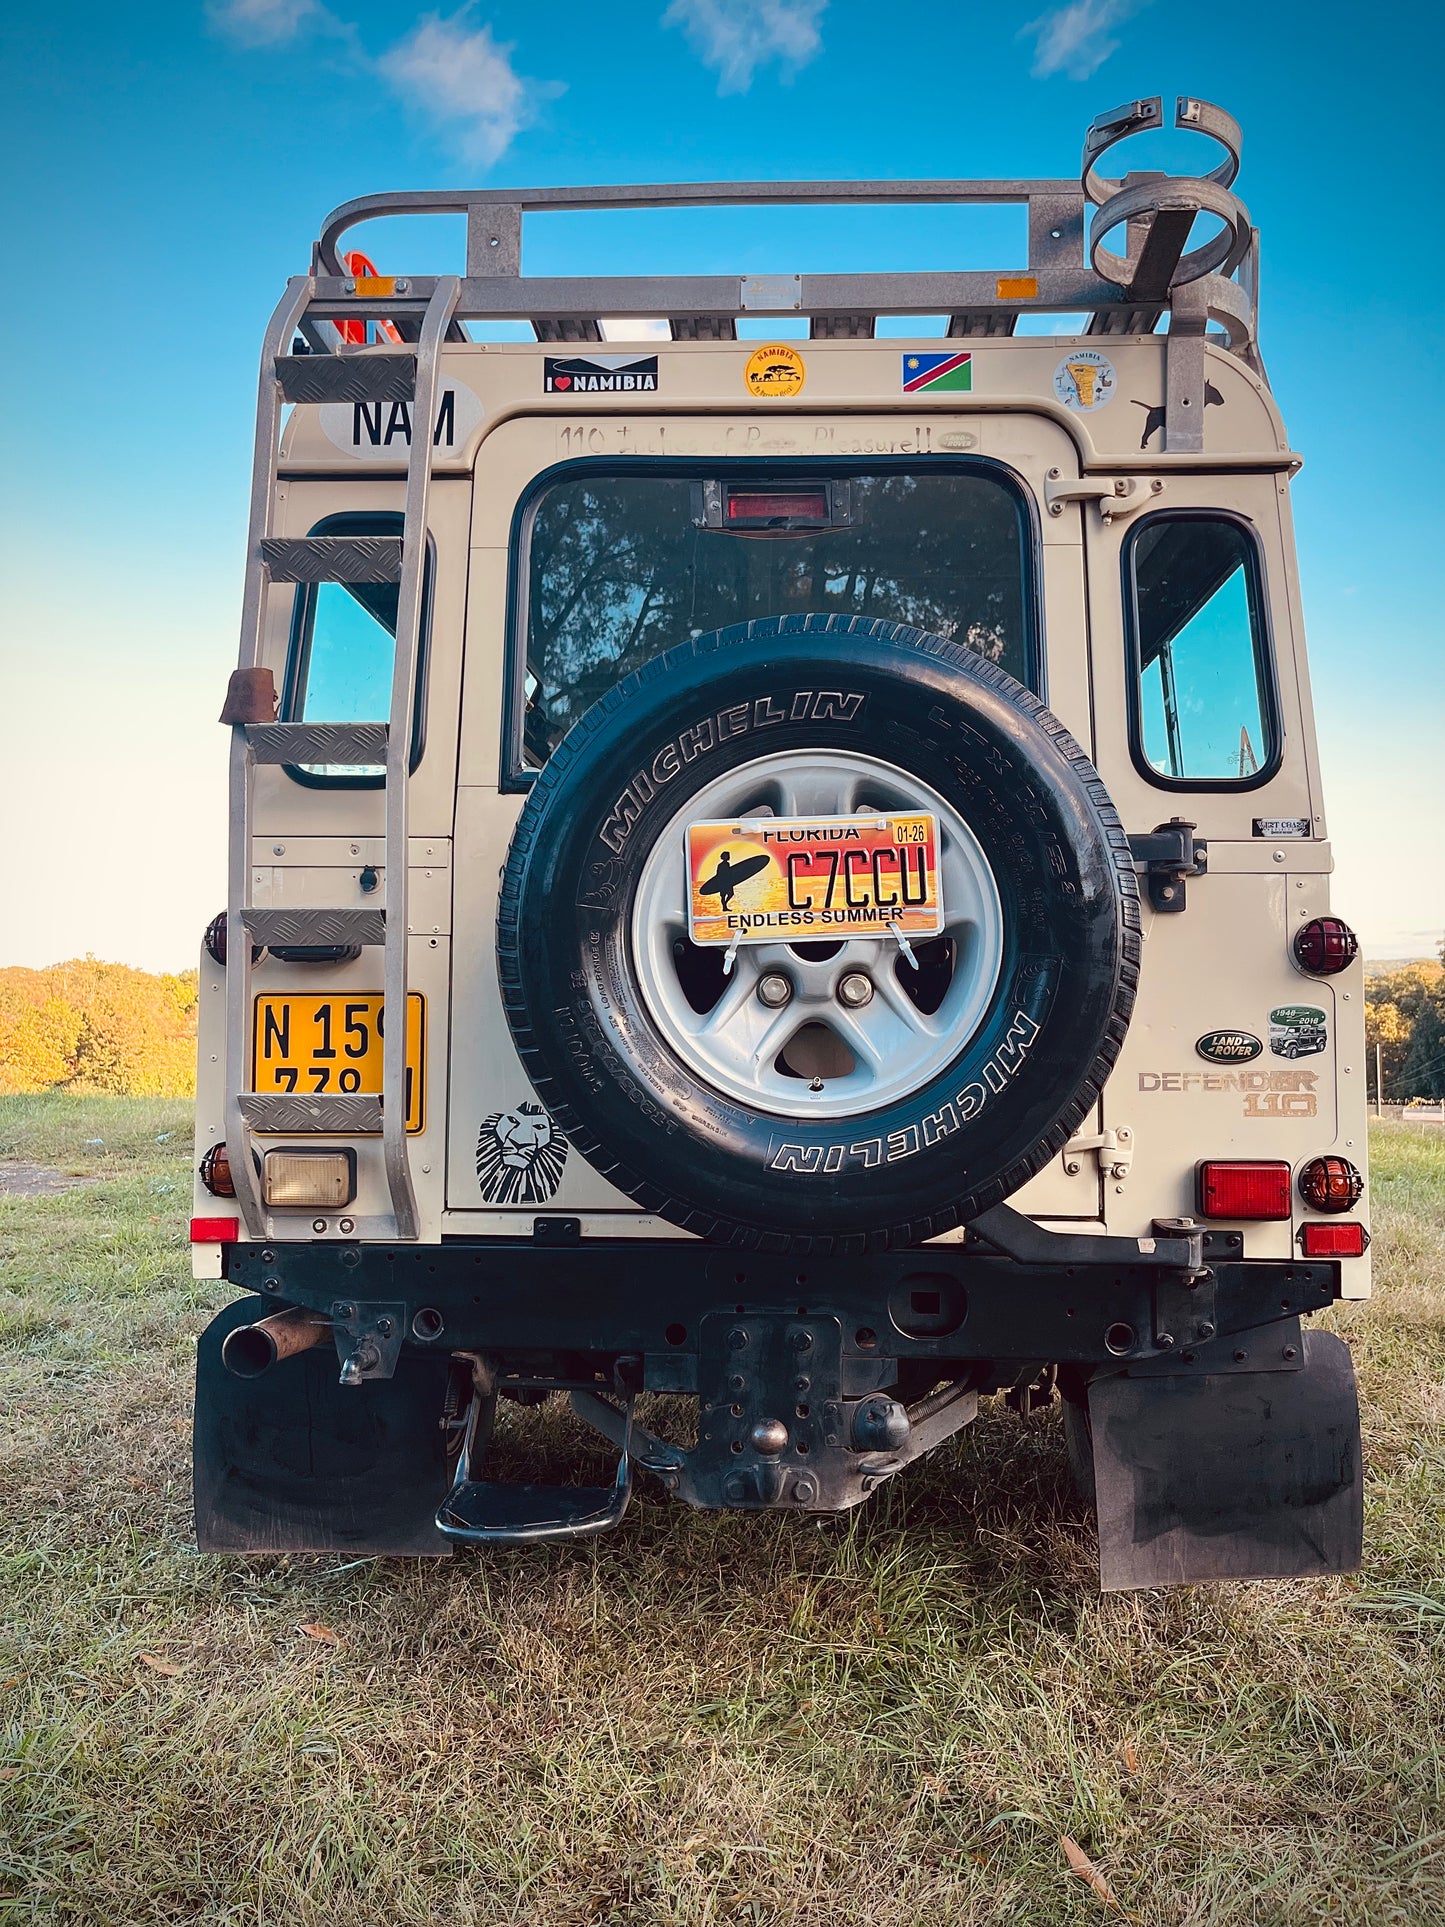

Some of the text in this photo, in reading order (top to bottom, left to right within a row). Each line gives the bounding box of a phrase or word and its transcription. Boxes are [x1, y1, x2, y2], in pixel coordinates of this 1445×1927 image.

[757, 348, 794, 361] NAMIBIA
[1069, 352, 1101, 361] NAMIBIA
[573, 375, 655, 391] NAMIBIA
[560, 426, 605, 453] 110
[598, 691, 865, 855] MICHELIN
[763, 827, 860, 843] FLORIDA
[896, 823, 925, 843] 01-26
[787, 846, 928, 910] C7CCU
[727, 908, 904, 929] ENDLESS SUMMER
[1276, 1009, 1296, 1017] 1948
[1299, 1017, 1319, 1025] 2018
[264, 1004, 290, 1059] N
[1211, 1035, 1243, 1046] LAND
[1213, 1046, 1253, 1057] ROVER
[1137, 1069, 1320, 1093] DEFENDER
[770, 1010, 1042, 1174] MICHELIN
[1242, 1092, 1318, 1118] 110
